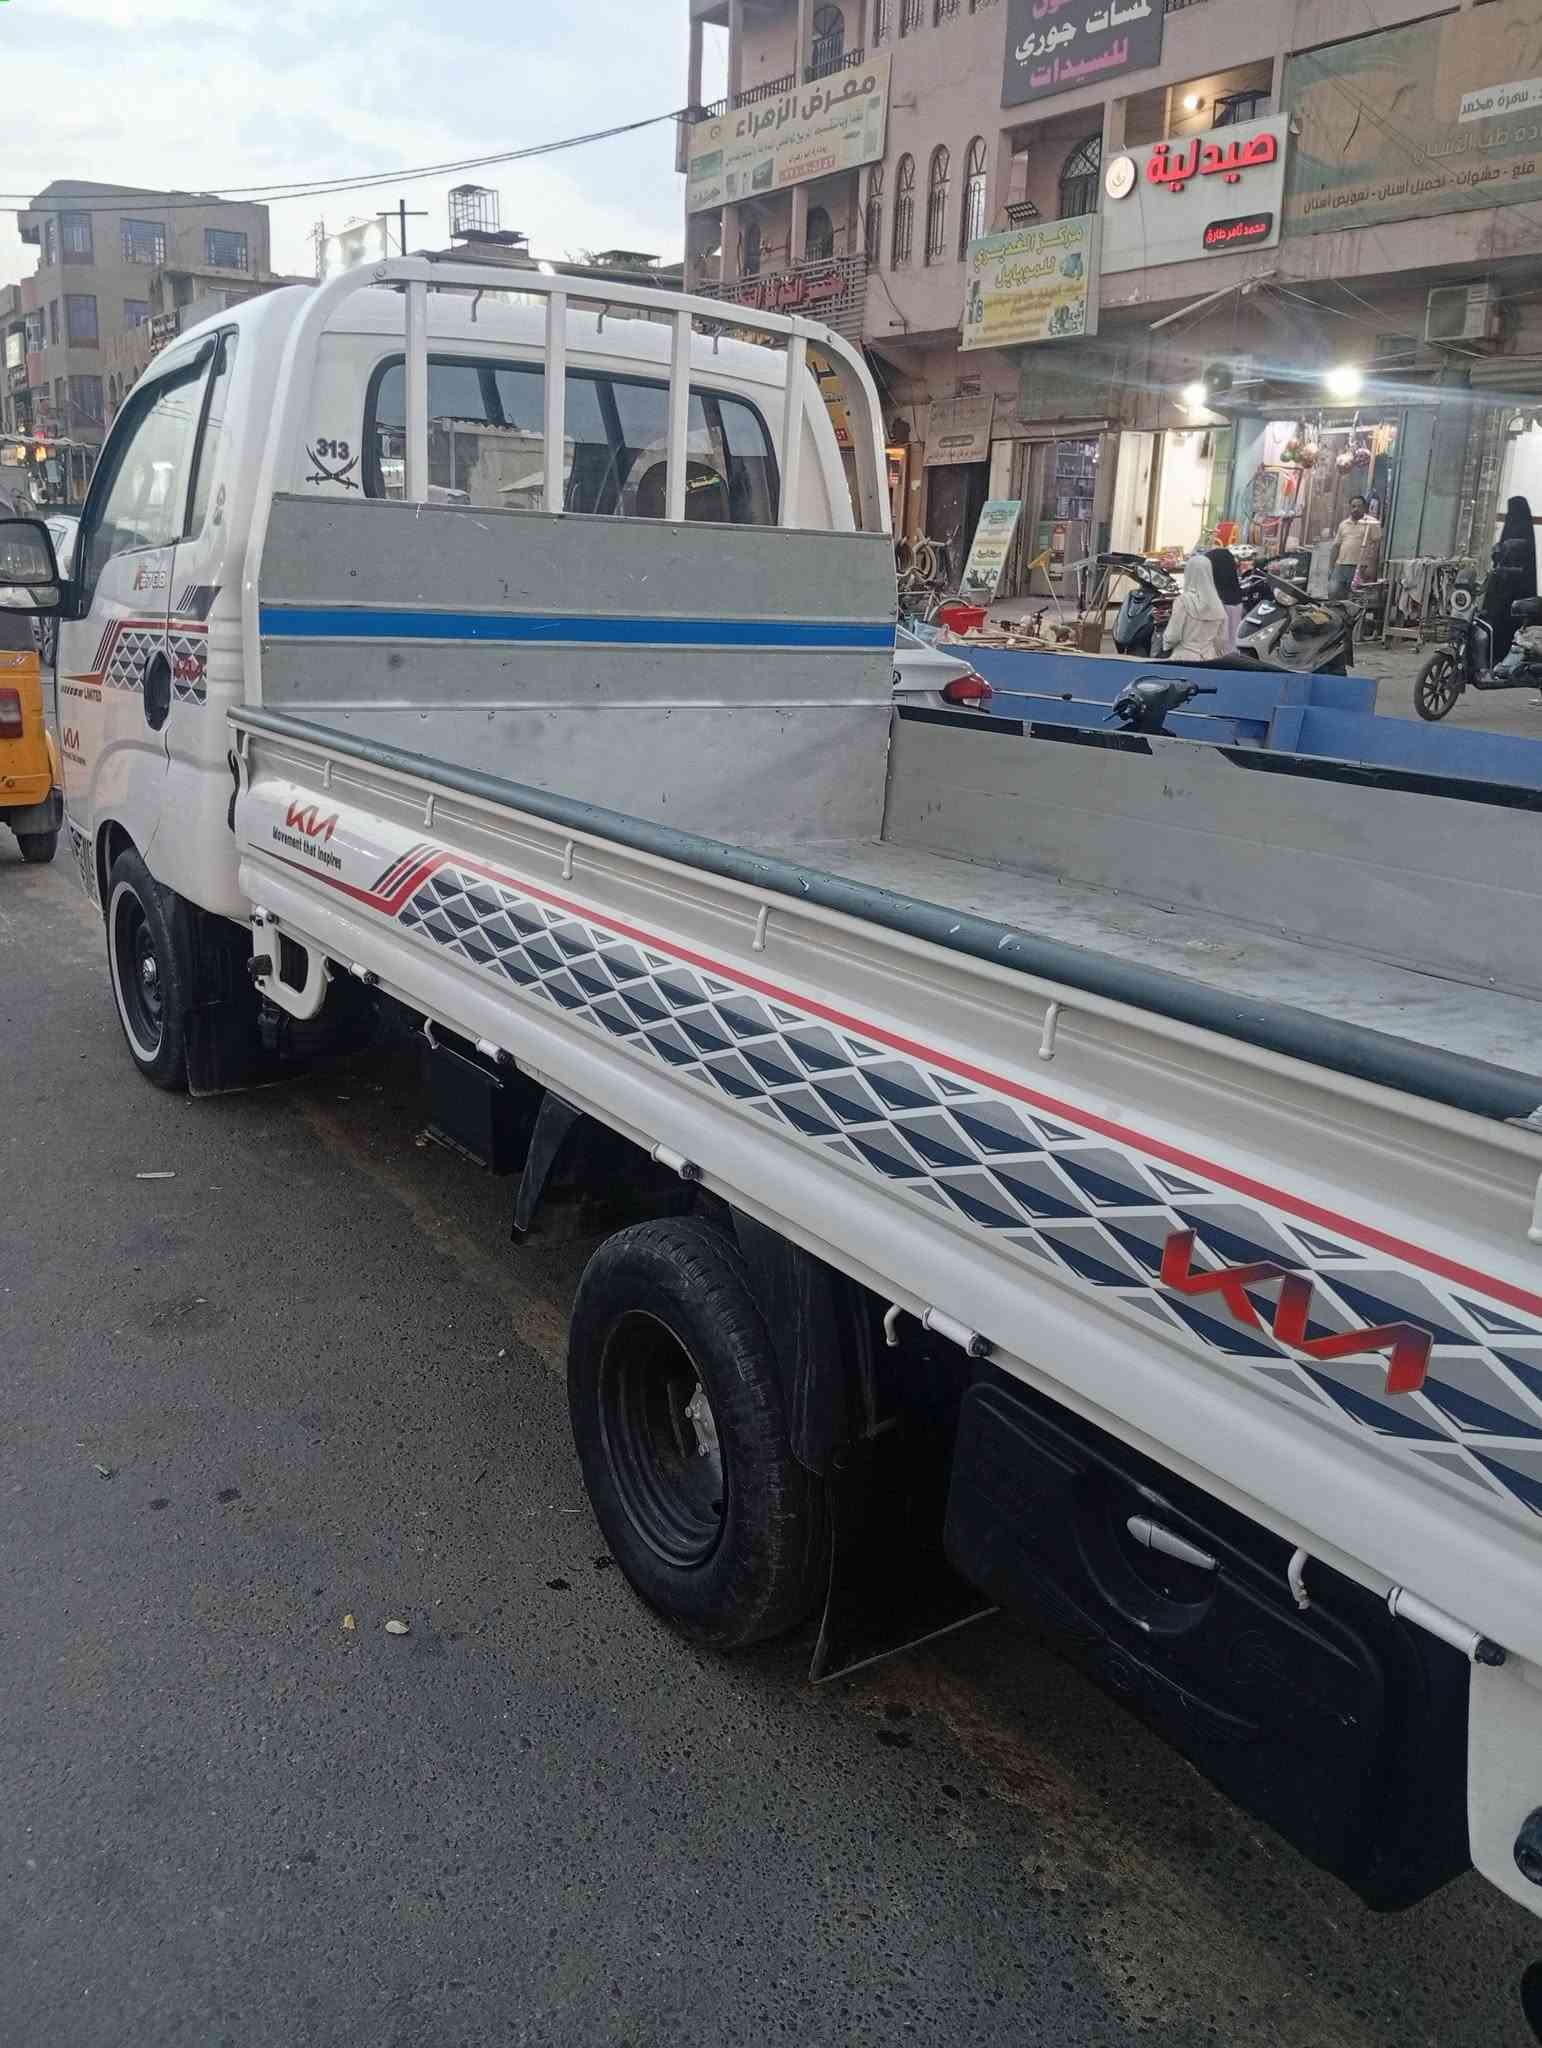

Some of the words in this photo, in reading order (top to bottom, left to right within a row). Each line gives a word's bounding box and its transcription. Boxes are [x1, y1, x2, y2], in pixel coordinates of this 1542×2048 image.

[1015, 21, 1077, 67] جوري
[1030, 37, 1129, 87] للسيدات
[736, 97, 796, 139] الزهراء
[802, 75, 876, 118] معرض
[1147, 133, 1278, 193] صيدلية
[316, 438, 350, 461] 313
[272, 824, 302, 852] Movement
[303, 838, 317, 858] that
[286, 799, 339, 843] KIA
[1159, 1228, 1434, 1395] KIA
